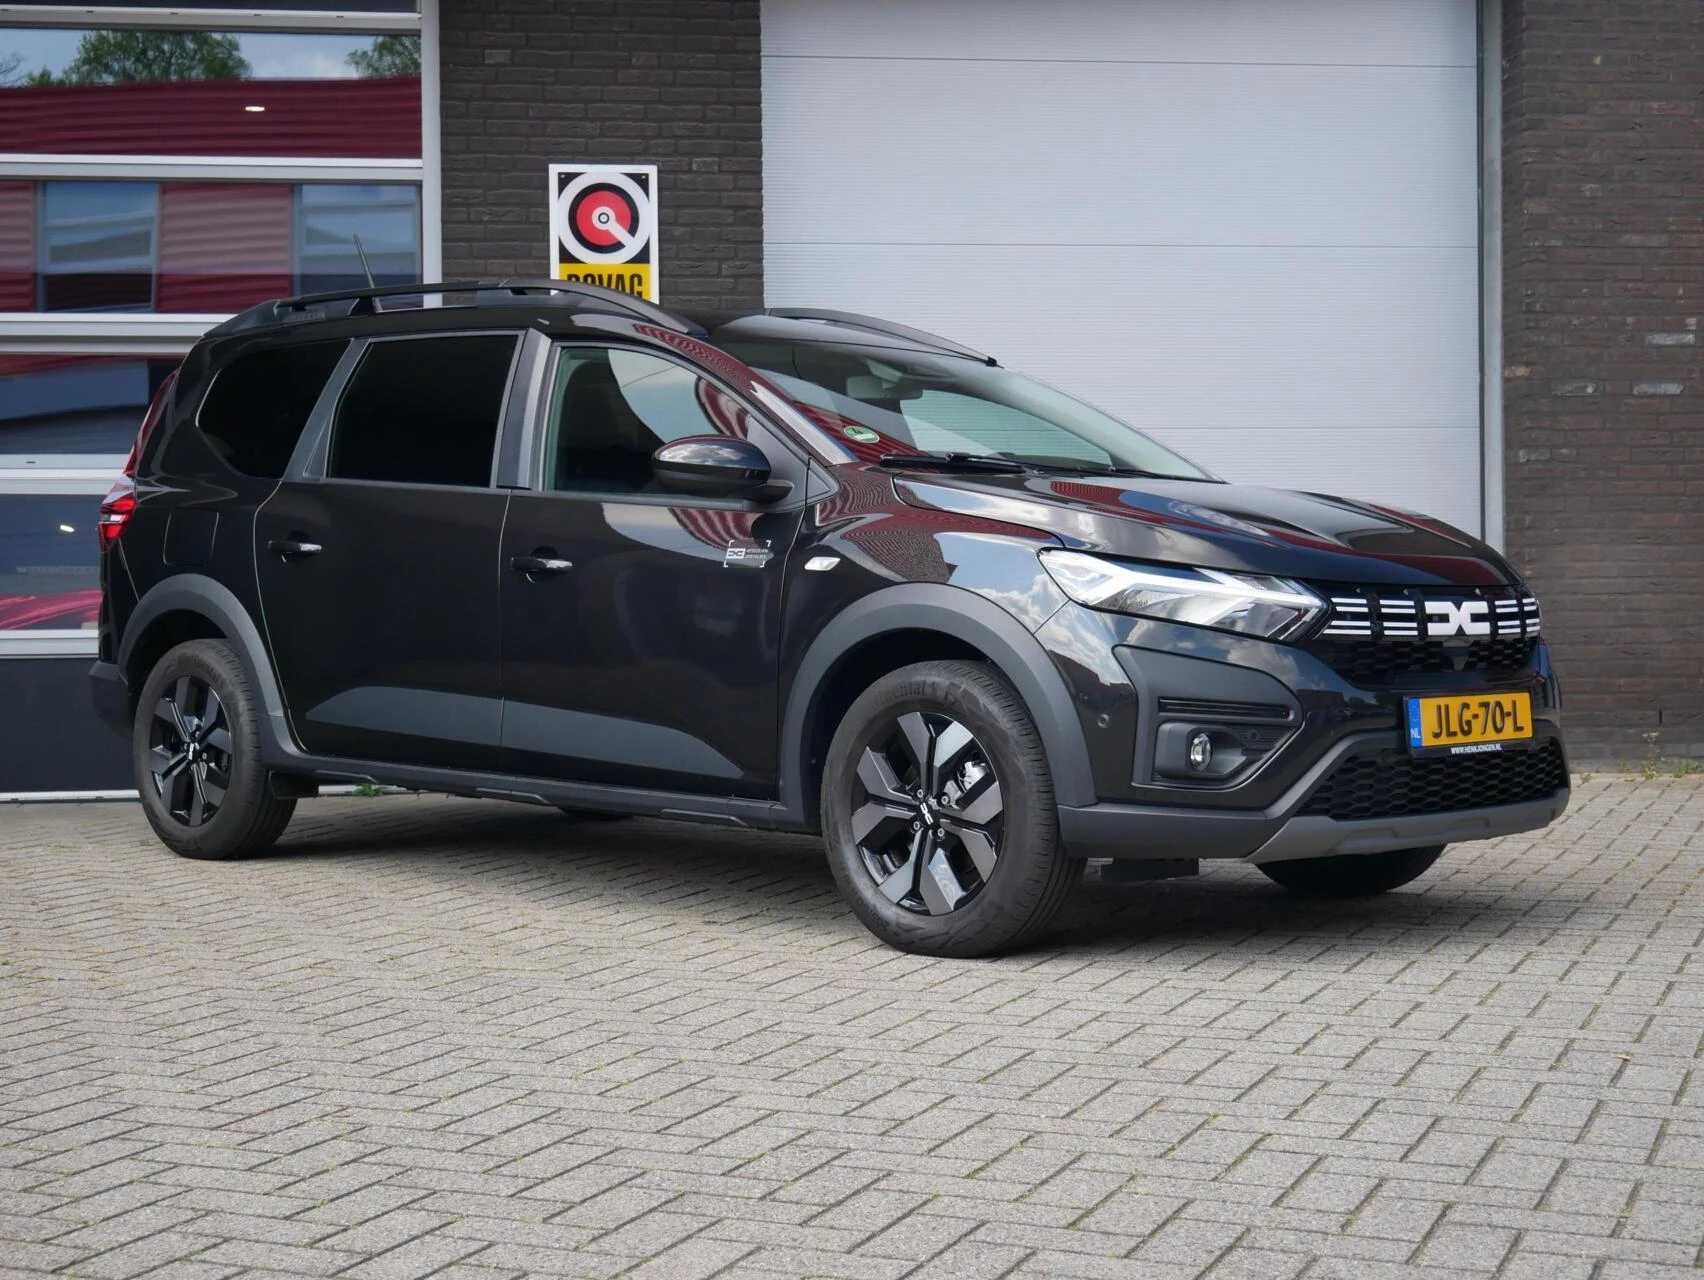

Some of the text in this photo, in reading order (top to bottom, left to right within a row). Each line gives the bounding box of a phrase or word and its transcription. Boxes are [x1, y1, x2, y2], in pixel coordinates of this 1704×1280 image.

[566, 271, 643, 299] VAG
[1431, 699, 1525, 739] JLG-70-L
[1410, 728, 1421, 739] NL
